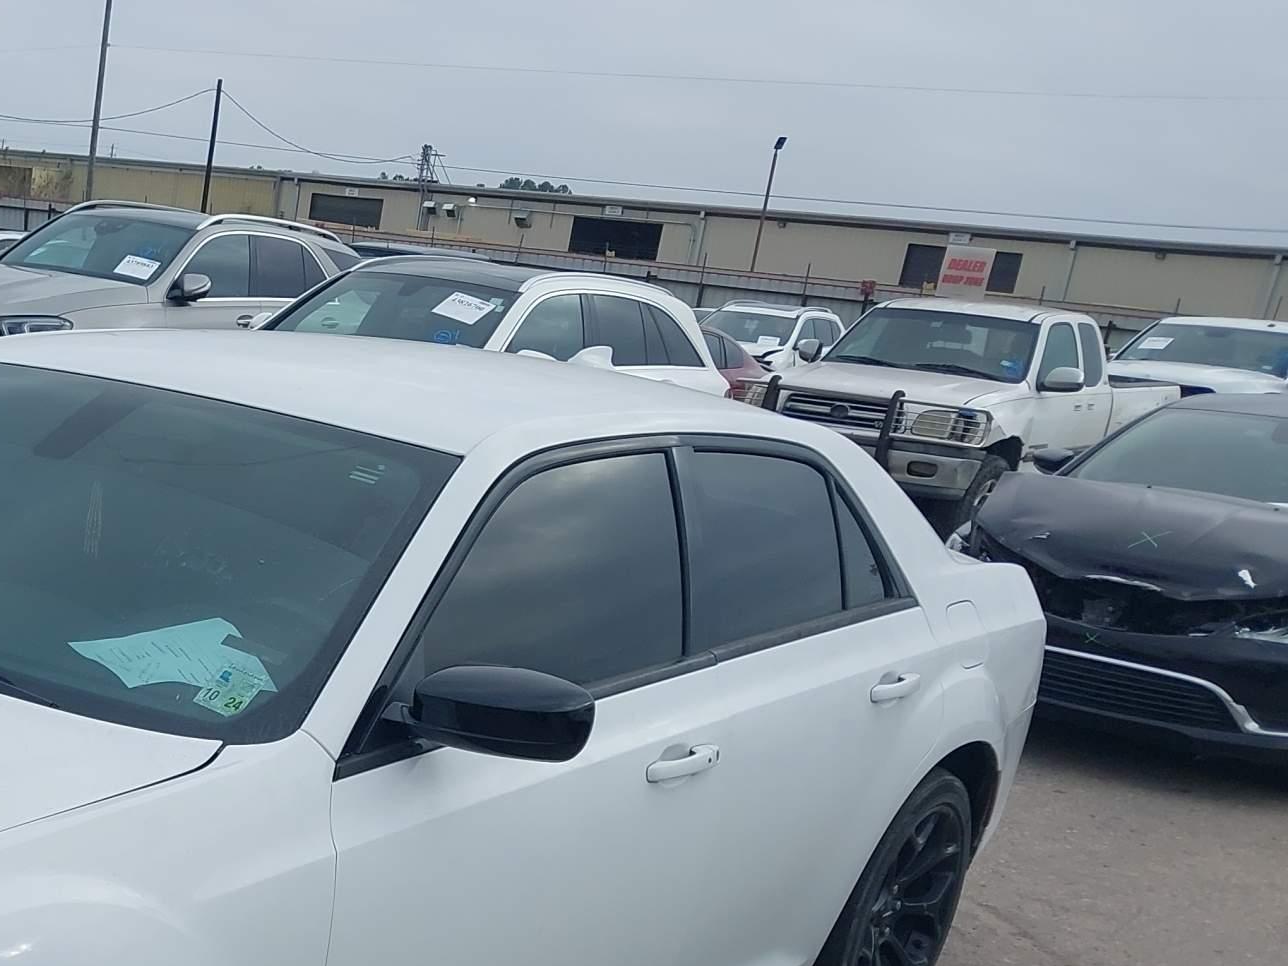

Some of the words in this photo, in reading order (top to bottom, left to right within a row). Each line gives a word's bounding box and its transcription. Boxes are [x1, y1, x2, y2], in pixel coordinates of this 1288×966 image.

[947, 258, 986, 272] DEALER
[202, 687, 221, 701] 10
[223, 696, 244, 711] 24
